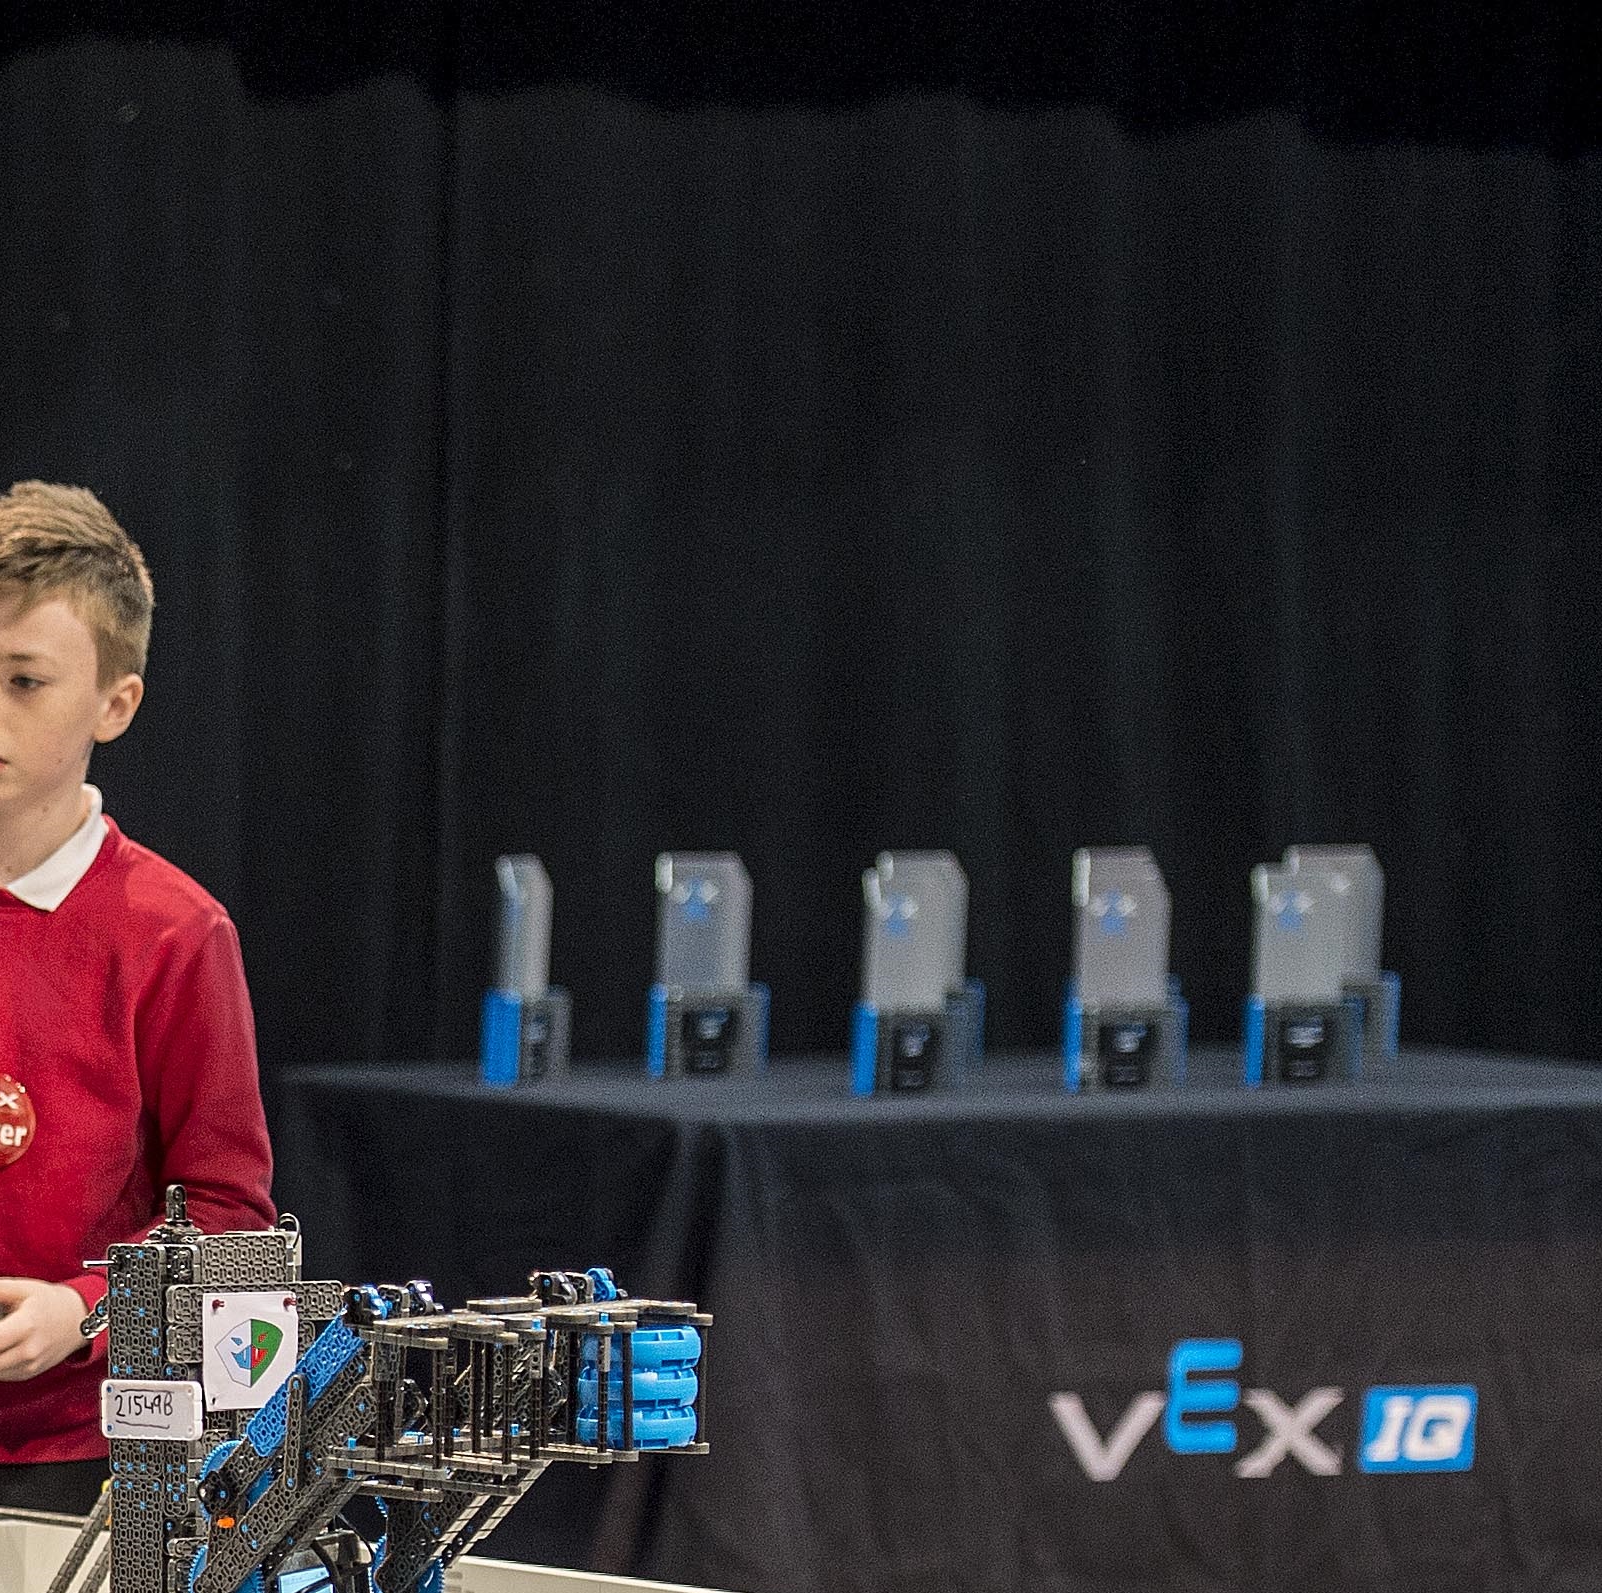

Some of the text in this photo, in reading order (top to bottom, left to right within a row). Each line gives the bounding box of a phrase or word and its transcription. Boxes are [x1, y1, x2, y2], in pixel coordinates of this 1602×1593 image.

[115, 1391, 174, 1417] 21549B
[1048, 1338, 1475, 1482] VEX IQ
